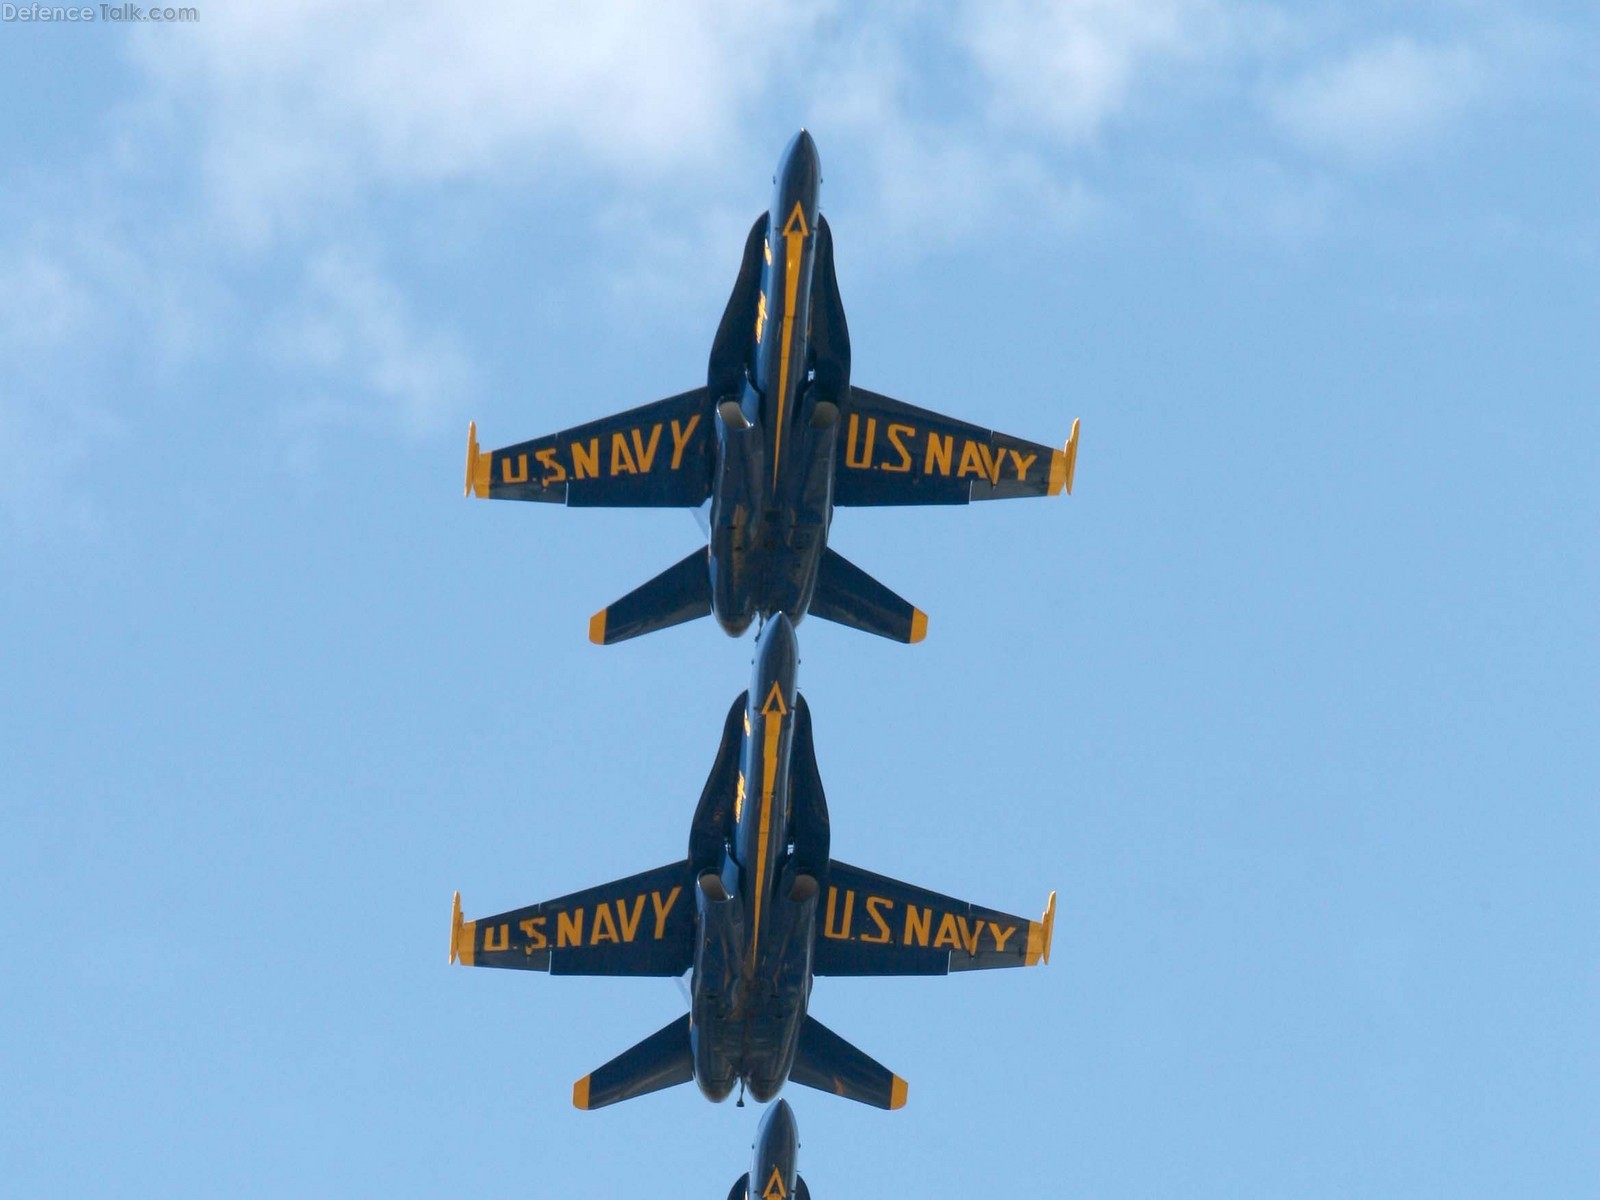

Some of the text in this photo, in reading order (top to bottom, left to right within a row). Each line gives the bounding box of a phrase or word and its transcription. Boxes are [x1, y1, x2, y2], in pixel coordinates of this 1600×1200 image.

[571, 416, 699, 479] NAVY
[924, 431, 1037, 484] NAVY
[557, 886, 681, 948] NAVY
[903, 903, 1016, 954] NAVY
